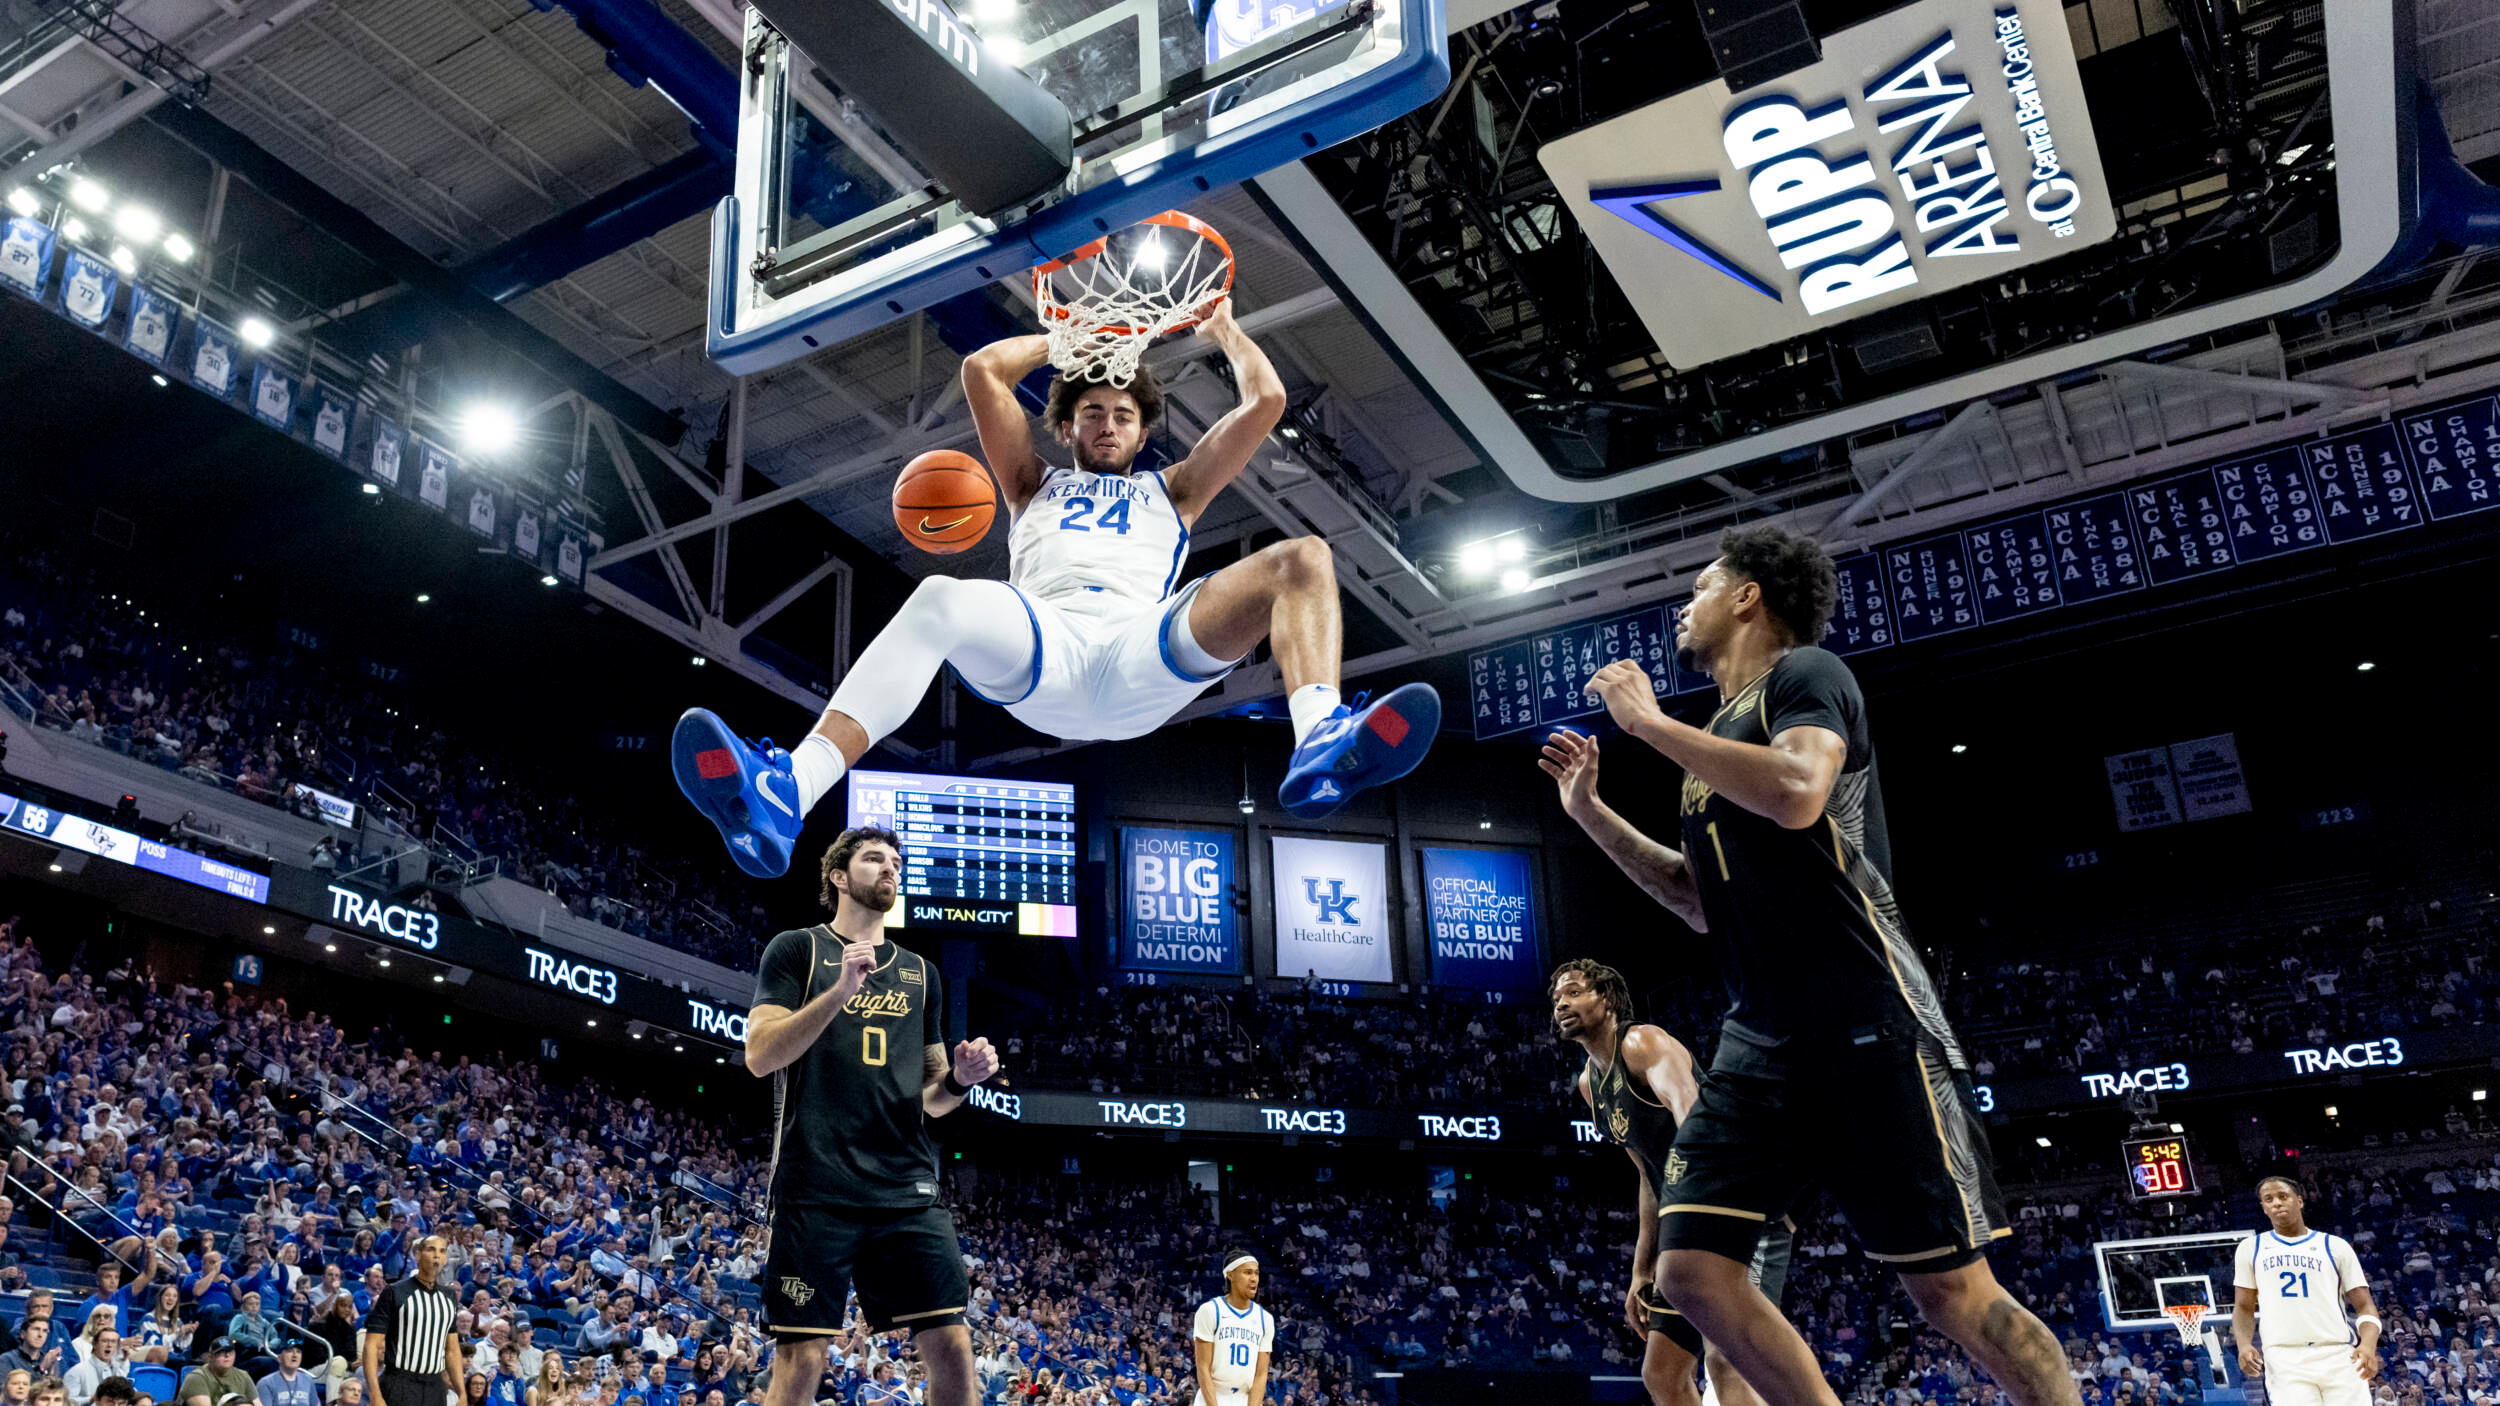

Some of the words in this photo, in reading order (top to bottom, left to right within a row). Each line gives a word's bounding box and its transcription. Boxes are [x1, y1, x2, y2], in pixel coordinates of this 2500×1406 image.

[1996, 15, 2032, 77] Center
[2008, 74, 2045, 126] Bank
[1864, 38, 2021, 258] ARENA
[2020, 117, 2060, 180] Central
[1723, 100, 1918, 316] RUPP
[2048, 218, 2075, 239] at
[79, 286, 96, 302] 77
[2409, 419, 2453, 494] NCAA
[2446, 415, 2489, 502] CHAMPION
[1047, 478, 1150, 505] KENTUCKY
[2311, 444, 2351, 518] NCAA
[2345, 443, 2375, 499] RUNNER
[2362, 505, 2381, 527] UP
[2378, 450, 2413, 521] 1997
[1060, 497, 1131, 535] 24
[2219, 466, 2257, 538] NCAA
[2252, 462, 2290, 547] CHAMPION
[2285, 472, 2317, 542] 1996
[2135, 489, 2172, 561] NCAA
[2165, 488, 2189, 528] FINAL
[2178, 534, 2201, 568] FOUR
[2197, 496, 2231, 565] 1993
[1971, 531, 2003, 600] NCAA
[2049, 511, 2083, 581] NCAA
[2079, 509, 2101, 550] FINAL
[2090, 555, 2112, 588] FOUR
[2108, 518, 2139, 586] 1984
[1892, 551, 1920, 618] NCAA
[1920, 550, 1941, 600] RUNNER
[2000, 528, 2030, 607] CHAMPION
[2028, 536, 2056, 603] 1978
[1838, 570, 1858, 620] RUNNER
[1866, 579, 1887, 643] 1966
[1946, 558, 1971, 624] 1975
[1846, 627, 1862, 645] UP
[1929, 607, 1945, 626] UP
[1495, 657, 1508, 692] FINAL
[1537, 638, 1557, 699] NCAA
[1561, 637, 1578, 709] CHAMPION
[1648, 633, 1668, 692] 1949
[1472, 658, 1492, 718] NCAA
[1515, 664, 1531, 722] 1942
[616, 736, 645, 750] 217
[22, 805, 49, 833] 56
[86, 822, 116, 856] UCF
[139, 841, 167, 859] POSS
[1135, 838, 1190, 856] HOME
[1194, 842, 1219, 858] TO
[1706, 821, 1730, 881] 1
[201, 860, 234, 879] TIMEOUTS
[1135, 855, 1219, 896] BIG
[2065, 850, 2098, 868] 223
[1302, 875, 1360, 926] UK
[1433, 877, 1497, 893] OFFICIAL
[1434, 892, 1527, 910] HEALTHCARE
[327, 884, 439, 951] TRACE3
[913, 906, 943, 920] SUN
[944, 908, 976, 922] TAN
[1136, 894, 1221, 925] BLUE
[1435, 906, 1498, 923] PARTNER
[1501, 910, 1522, 923] OF
[1136, 923, 1222, 943] DETERMI
[1294, 927, 1374, 946] HealthCare
[1436, 923, 1470, 941] BIG
[1474, 925, 1523, 943] BLUE
[1437, 941, 1515, 961] NATION
[238, 959, 258, 979] 15
[525, 947, 617, 1004] TRACE3
[1127, 972, 1156, 986] 218
[1321, 982, 1350, 996] 219
[542, 1040, 558, 1059] 16
[862, 1026, 887, 1066] 0
[2285, 1038, 2404, 1075] TRACE3
[2082, 1064, 2190, 1098] TRACE3
[1099, 1101, 1187, 1128] TRACE3
[1261, 1108, 1346, 1134] TRACE3
[1419, 1115, 1501, 1141] TRACE3
[2141, 1143, 2180, 1162] 5:42
[2141, 1161, 2184, 1192] 30
[2263, 1254, 2322, 1272] KENTUCKY
[780, 1276, 814, 1306] UCF
[2279, 1271, 2309, 1298] 21
[1219, 1326, 1260, 1346] KENTUCKY
[1230, 1342, 1249, 1367] 10
